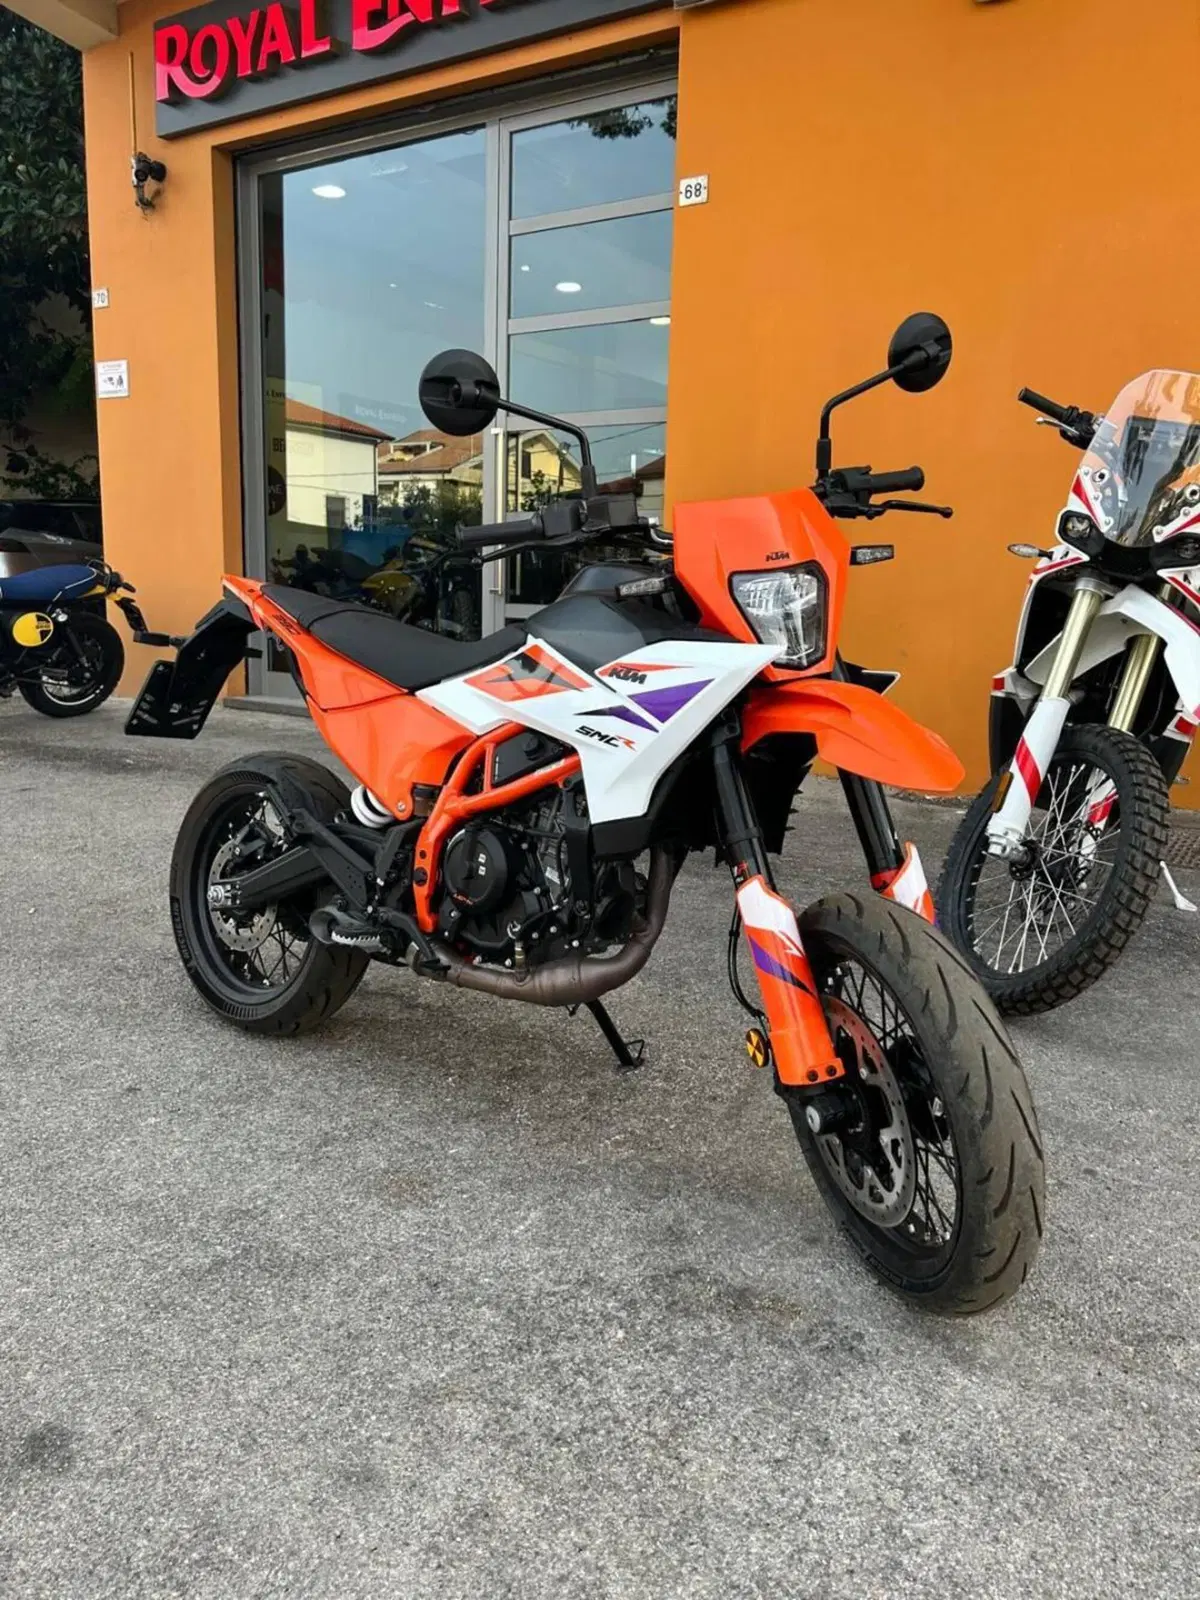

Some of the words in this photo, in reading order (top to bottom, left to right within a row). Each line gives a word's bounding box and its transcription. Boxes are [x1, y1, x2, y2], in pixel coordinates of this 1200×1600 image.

[155, 0, 331, 101] ROYAL
[684, 182, 702, 199] 68
[766, 551, 790, 562] KTM
[608, 666, 647, 684] KTM
